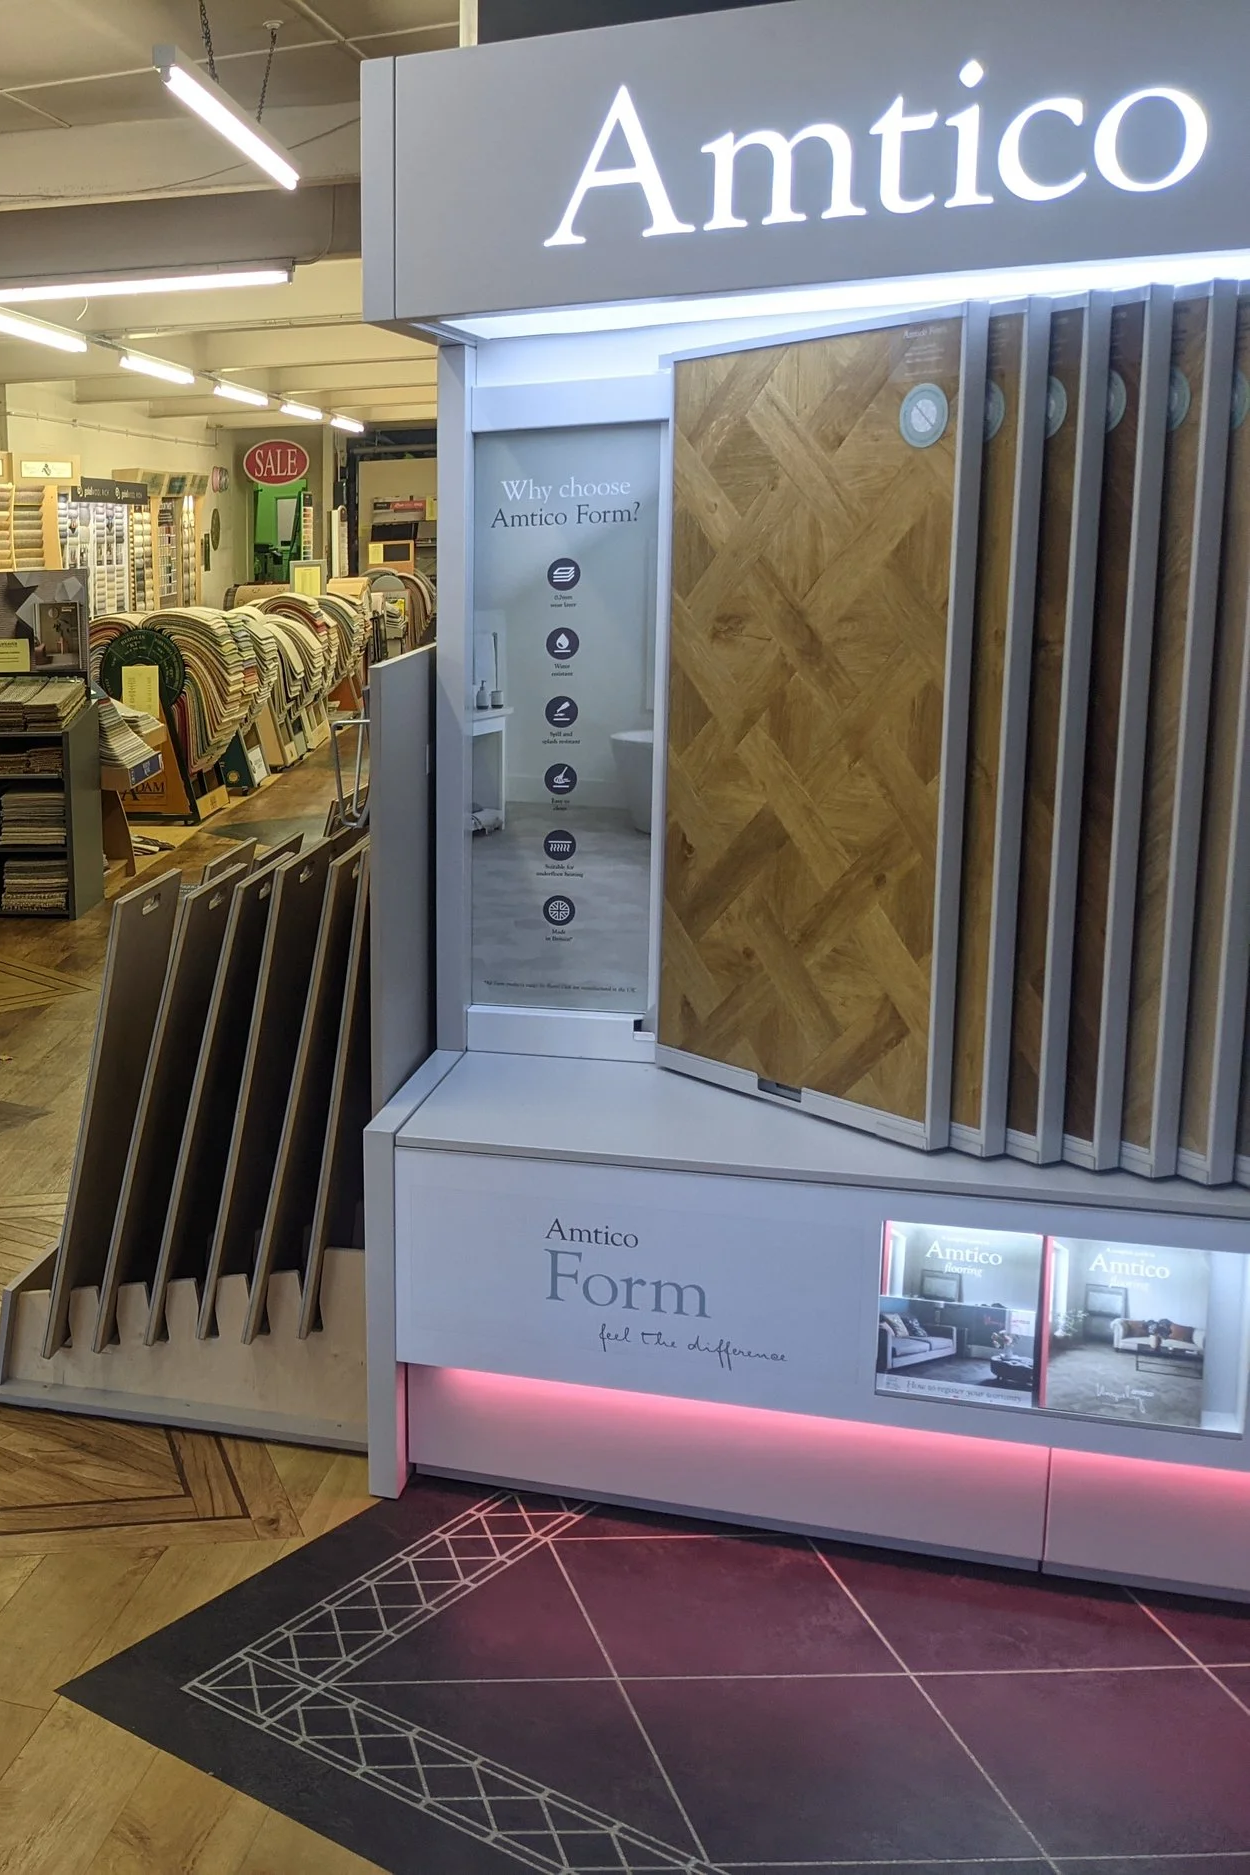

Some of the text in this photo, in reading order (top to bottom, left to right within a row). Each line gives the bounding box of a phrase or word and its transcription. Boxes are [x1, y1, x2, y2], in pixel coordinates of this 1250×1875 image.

[544, 58, 1209, 248] Amtico
[254, 449, 298, 477] SALE
[501, 476, 631, 504] Why choose
[491, 501, 640, 529] Amtico Form?
[545, 1218, 639, 1249] Amtico
[926, 1239, 1003, 1266] Amtico
[1089, 1253, 1171, 1279] Amtico
[544, 1248, 712, 1319] Form
[943, 1262, 983, 1277] flooring
[599, 1323, 789, 1370] feel the difference
